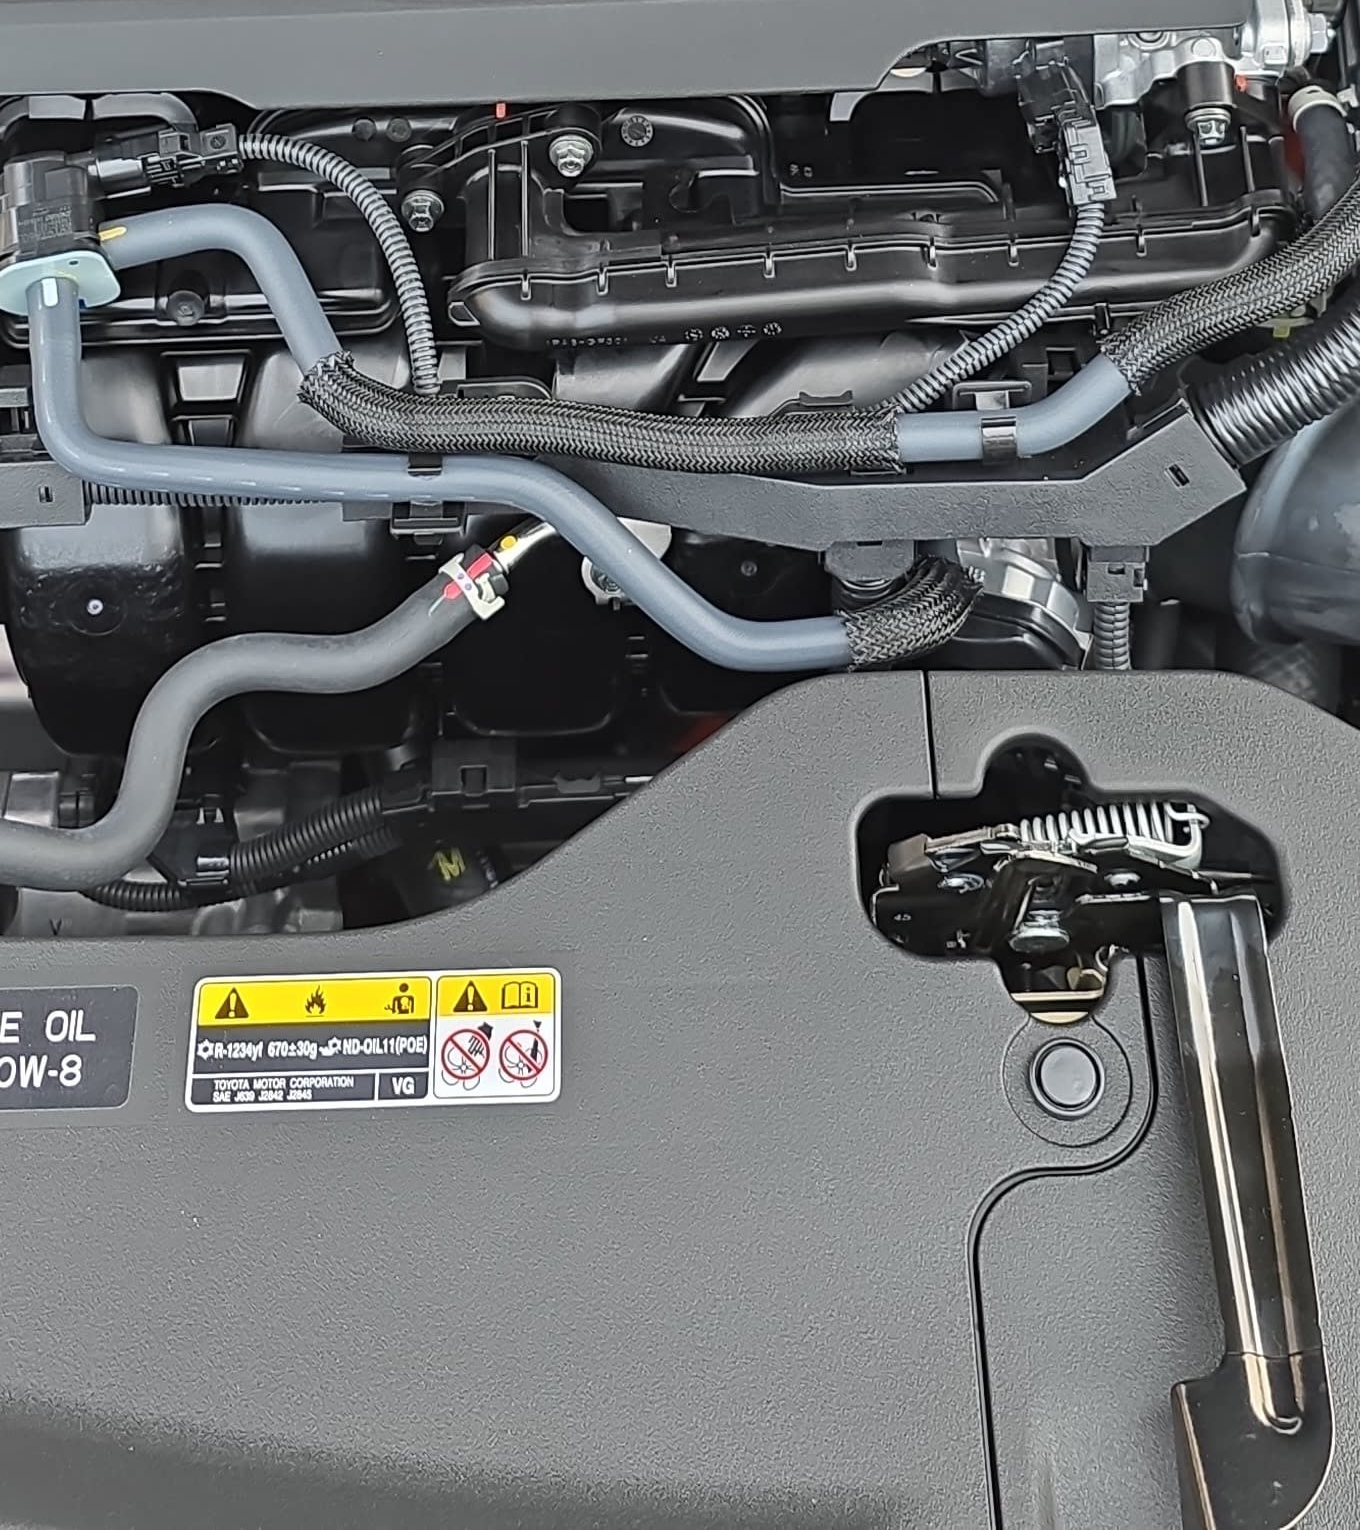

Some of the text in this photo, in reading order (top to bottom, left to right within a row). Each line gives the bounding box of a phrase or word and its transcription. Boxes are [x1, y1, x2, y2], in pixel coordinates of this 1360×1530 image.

[45, 1006, 98, 1043] OIL
[213, 1035, 428, 1062] R-1234yf 670±30g ND-OIL11(POE)
[213, 1075, 355, 1090] TOYOTA MOTOR CORPORATION
[391, 1077, 416, 1096] VG
[212, 1091, 231, 1103] SAE
